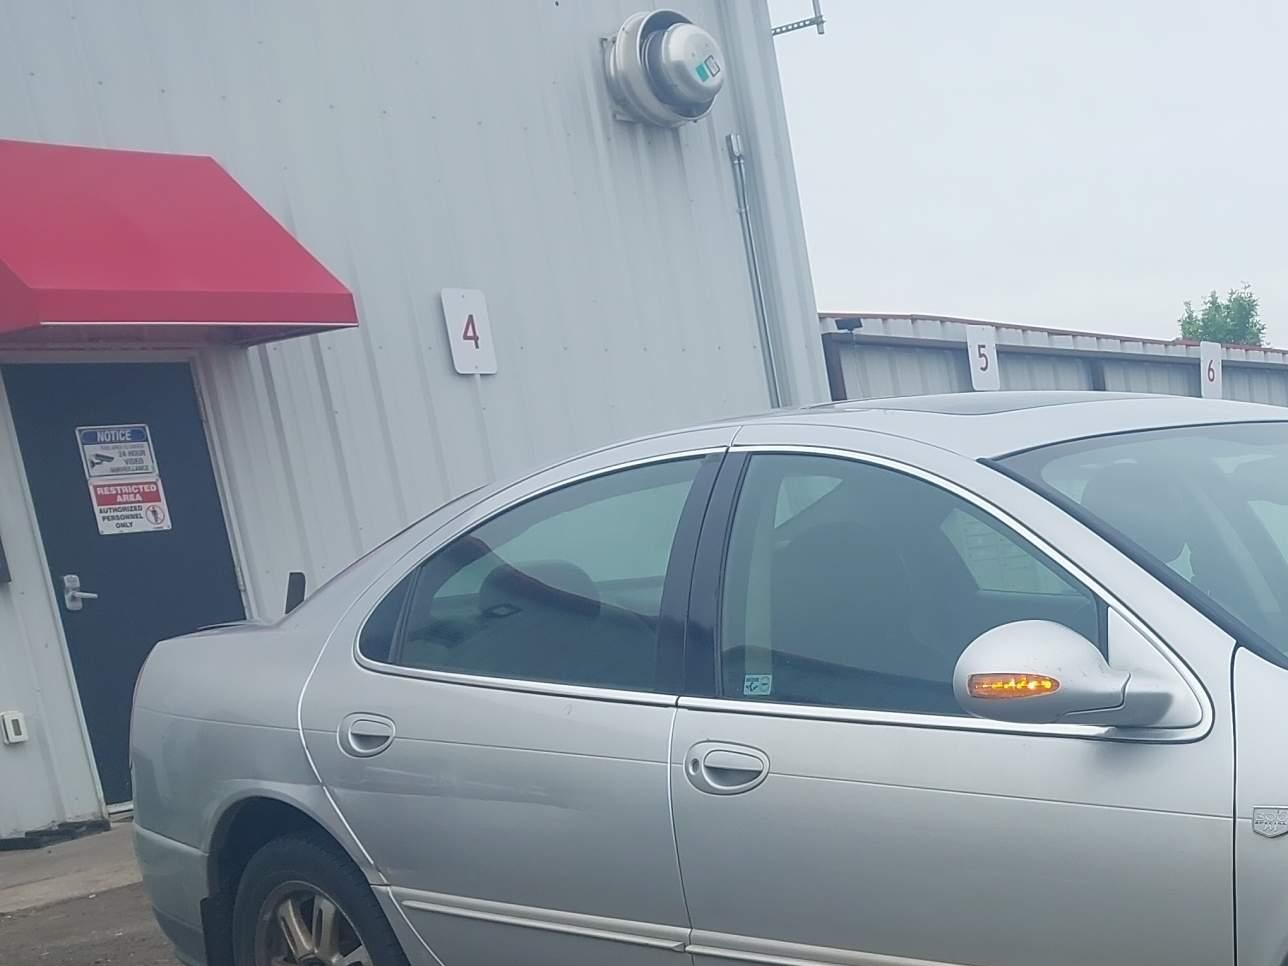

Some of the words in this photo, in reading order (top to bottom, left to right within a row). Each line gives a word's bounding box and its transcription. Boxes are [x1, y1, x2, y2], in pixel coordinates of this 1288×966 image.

[463, 314, 479, 349] 4
[978, 344, 988, 371] 5
[1208, 359, 1215, 382] 6
[97, 430, 132, 442] NOTICE
[96, 484, 157, 495] RESTRICTED
[116, 494, 143, 502] AREA
[99, 505, 142, 514] AUTHORIZED
[102, 513, 144, 522] PERSONNEL
